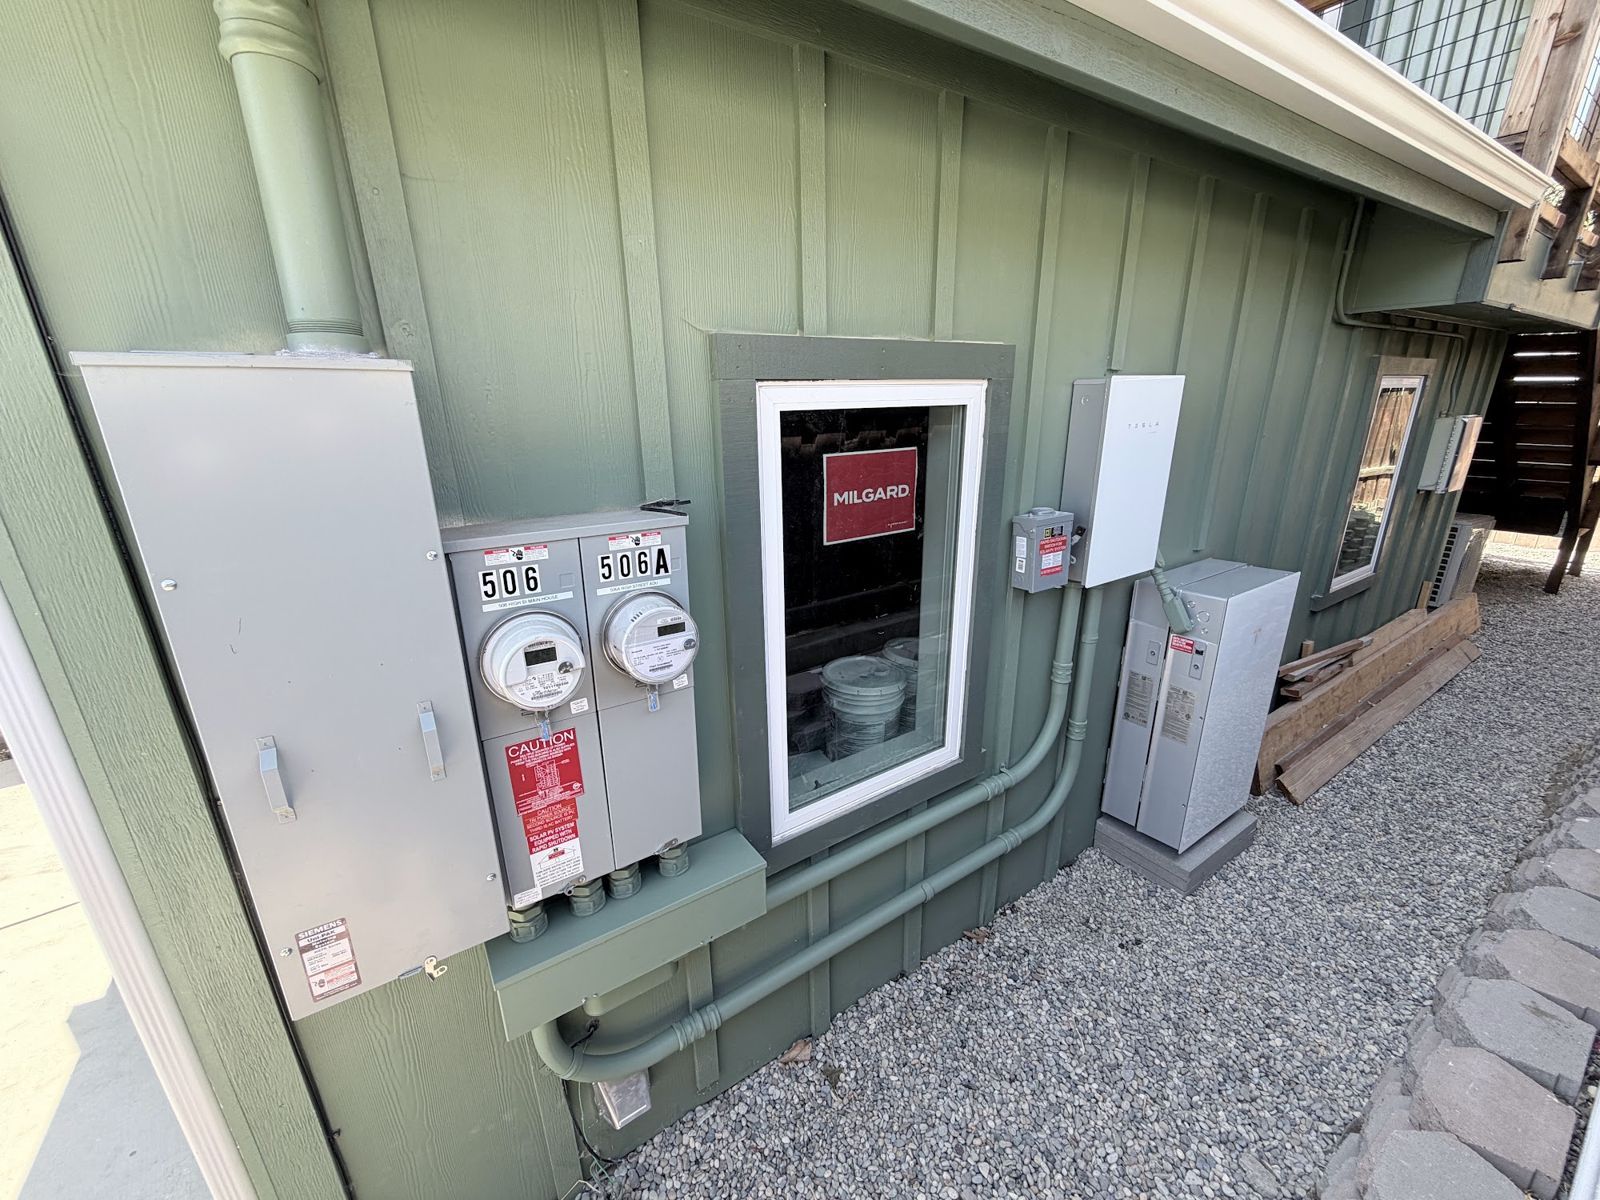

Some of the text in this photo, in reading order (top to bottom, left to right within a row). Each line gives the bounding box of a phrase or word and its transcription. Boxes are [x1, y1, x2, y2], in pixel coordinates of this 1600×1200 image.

[1127, 421, 1159, 430] TESLA
[833, 484, 909, 507] MILGARD
[600, 547, 669, 580] 506A
[482, 566, 539, 598] 506
[508, 729, 574, 757] CAUTION
[537, 803, 562, 815] CAUTION
[529, 831, 547, 842] SOLAR
[555, 821, 575, 833] SYSTEM
[531, 832, 576, 853] RAPID SHUTDOWN
[298, 919, 343, 939] SIEMENS
